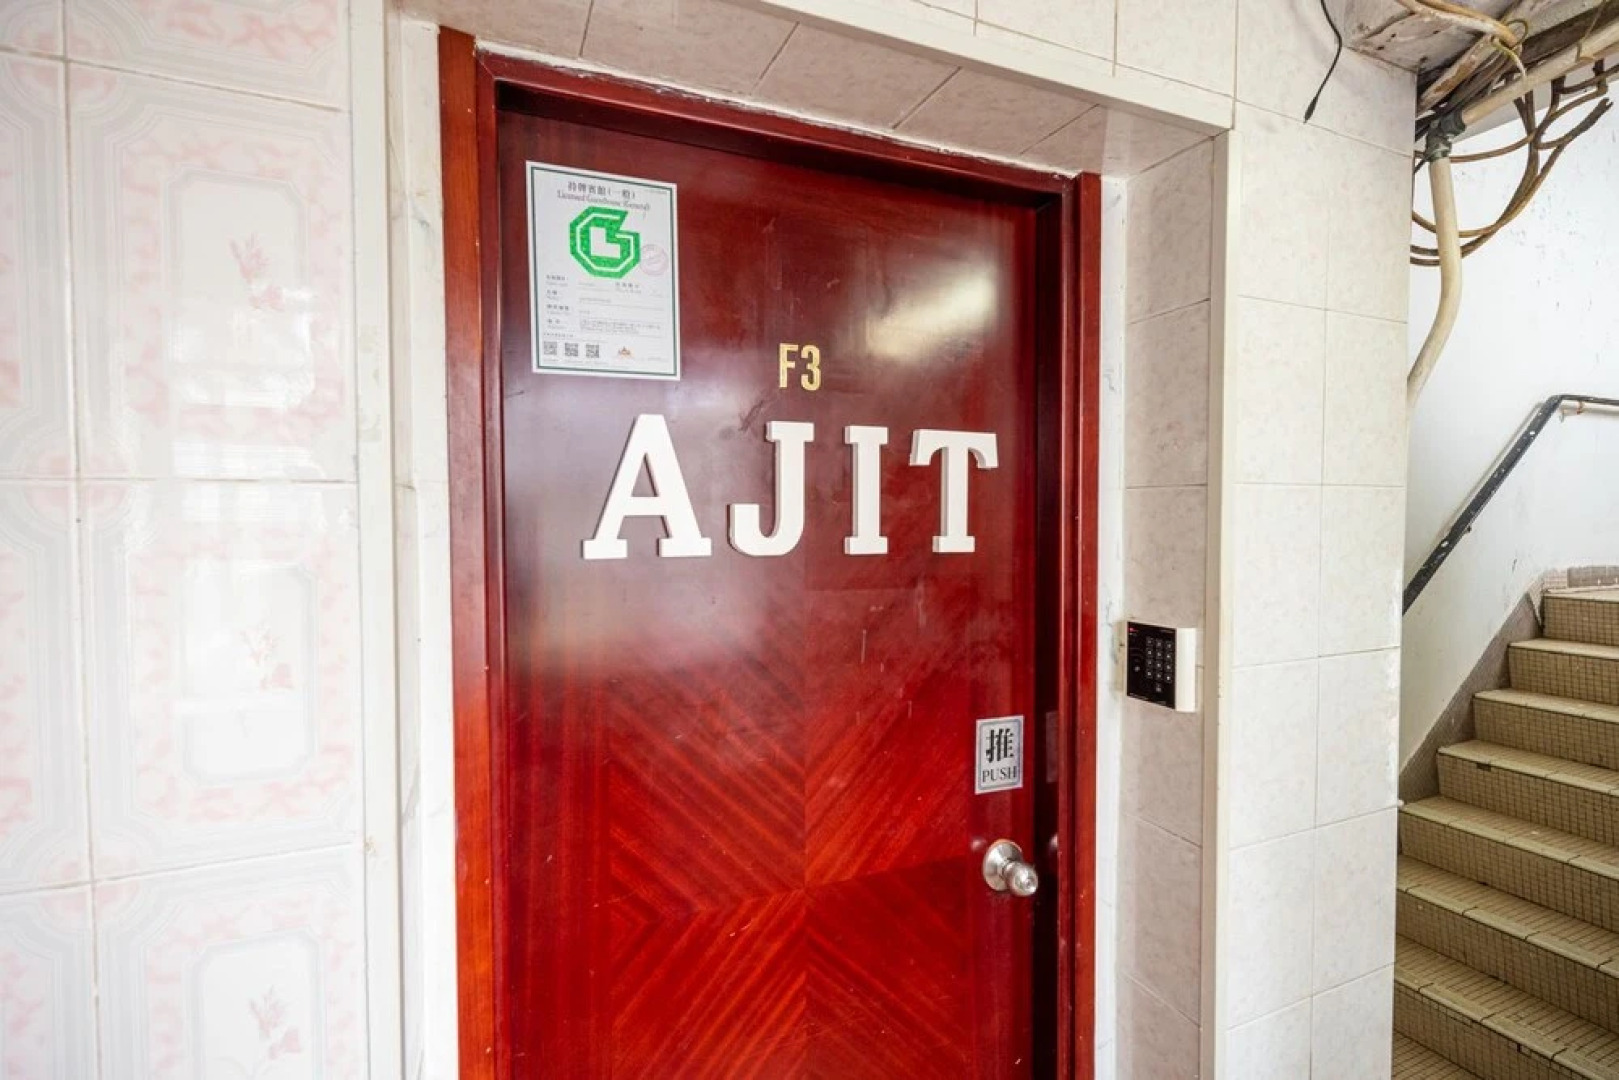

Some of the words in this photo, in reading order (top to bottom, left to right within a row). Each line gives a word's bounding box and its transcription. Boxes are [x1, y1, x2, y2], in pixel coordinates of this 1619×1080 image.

[778, 342, 822, 391] F3
[582, 413, 999, 560] AJIT
[985, 728, 1015, 763] 推
[982, 766, 1018, 782] PUSH
